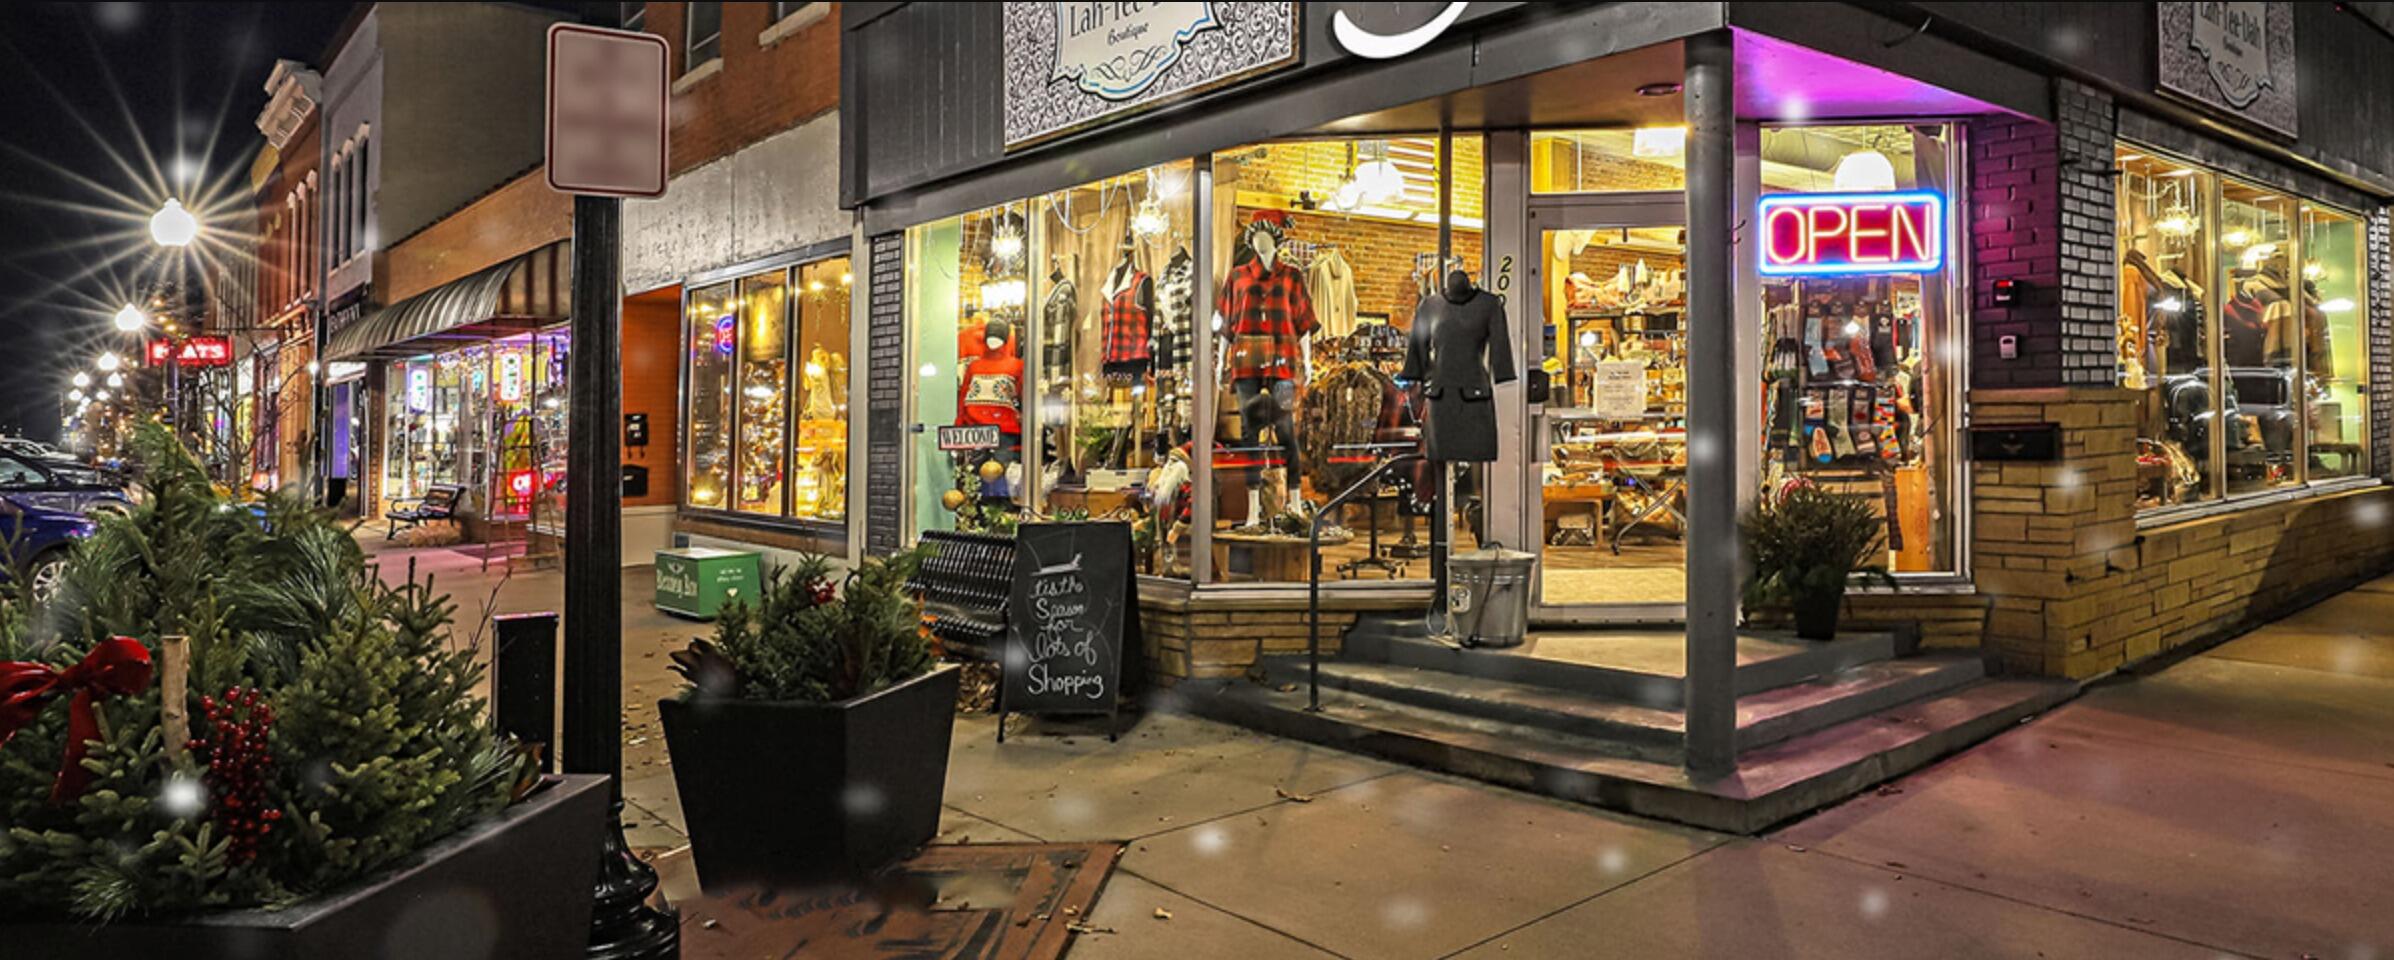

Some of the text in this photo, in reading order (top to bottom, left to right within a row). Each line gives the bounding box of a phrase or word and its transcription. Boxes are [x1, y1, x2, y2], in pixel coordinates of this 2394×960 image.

[1107, 23, 1149, 46] Boutique
[1767, 203, 1932, 264] OPEN
[152, 342, 226, 359] ATS
[942, 428, 999, 445] WELCOME
[1036, 597, 1084, 619] Season
[1039, 616, 1084, 640] for
[1028, 630, 1097, 666] lots of
[1027, 663, 1104, 699] Shopping
